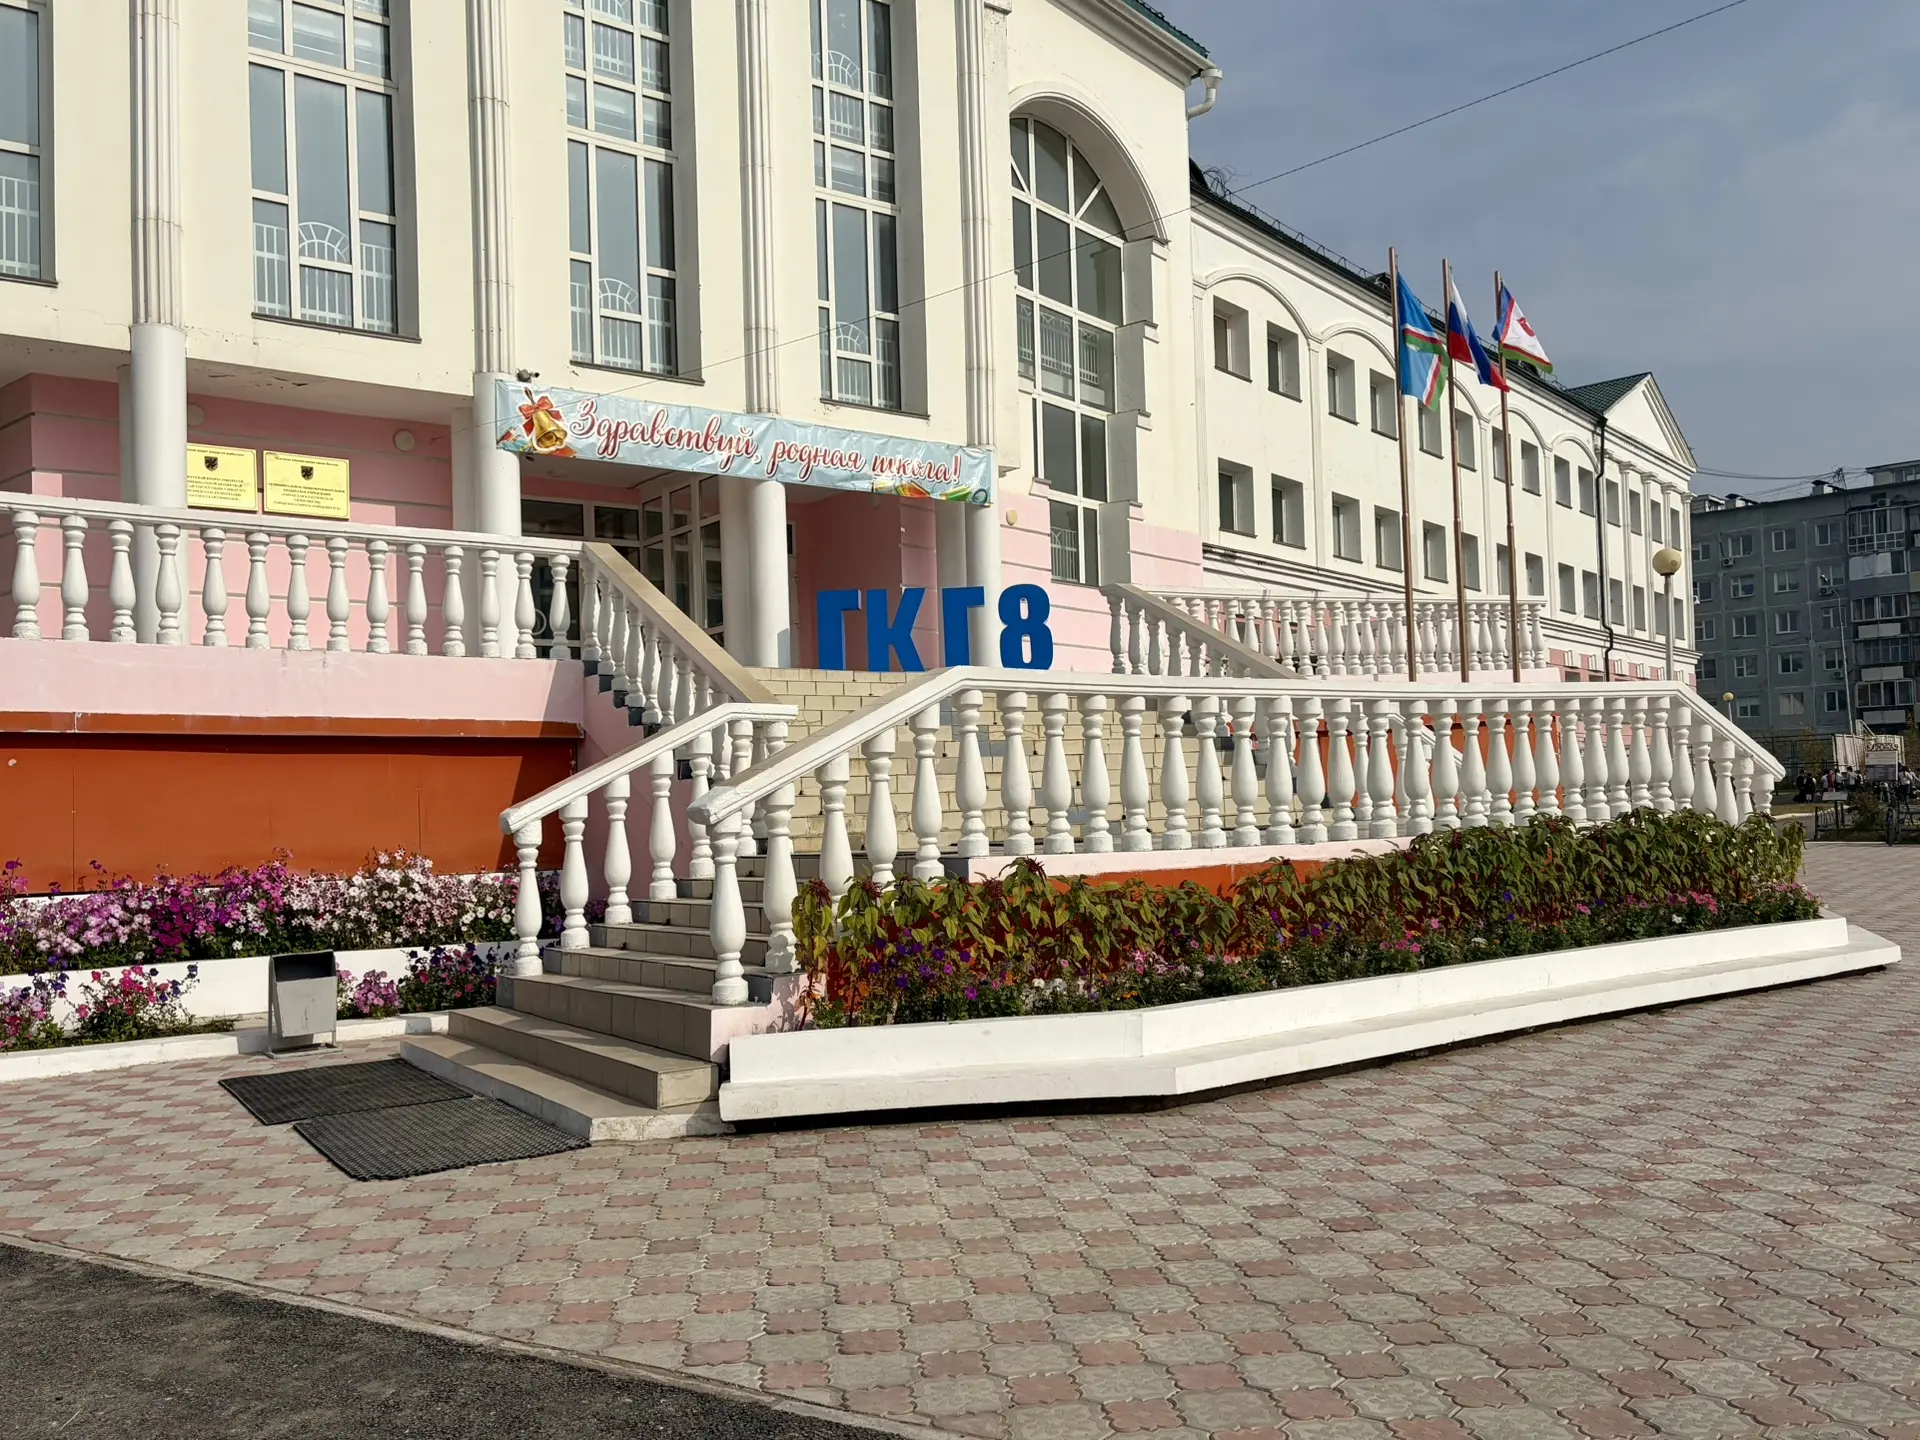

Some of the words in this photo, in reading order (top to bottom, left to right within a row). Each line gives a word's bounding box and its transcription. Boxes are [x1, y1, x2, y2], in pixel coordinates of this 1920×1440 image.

[569, 399, 761, 472] Здравствуй,
[765, 439, 866, 480] родная
[872, 453, 962, 483] школа!
